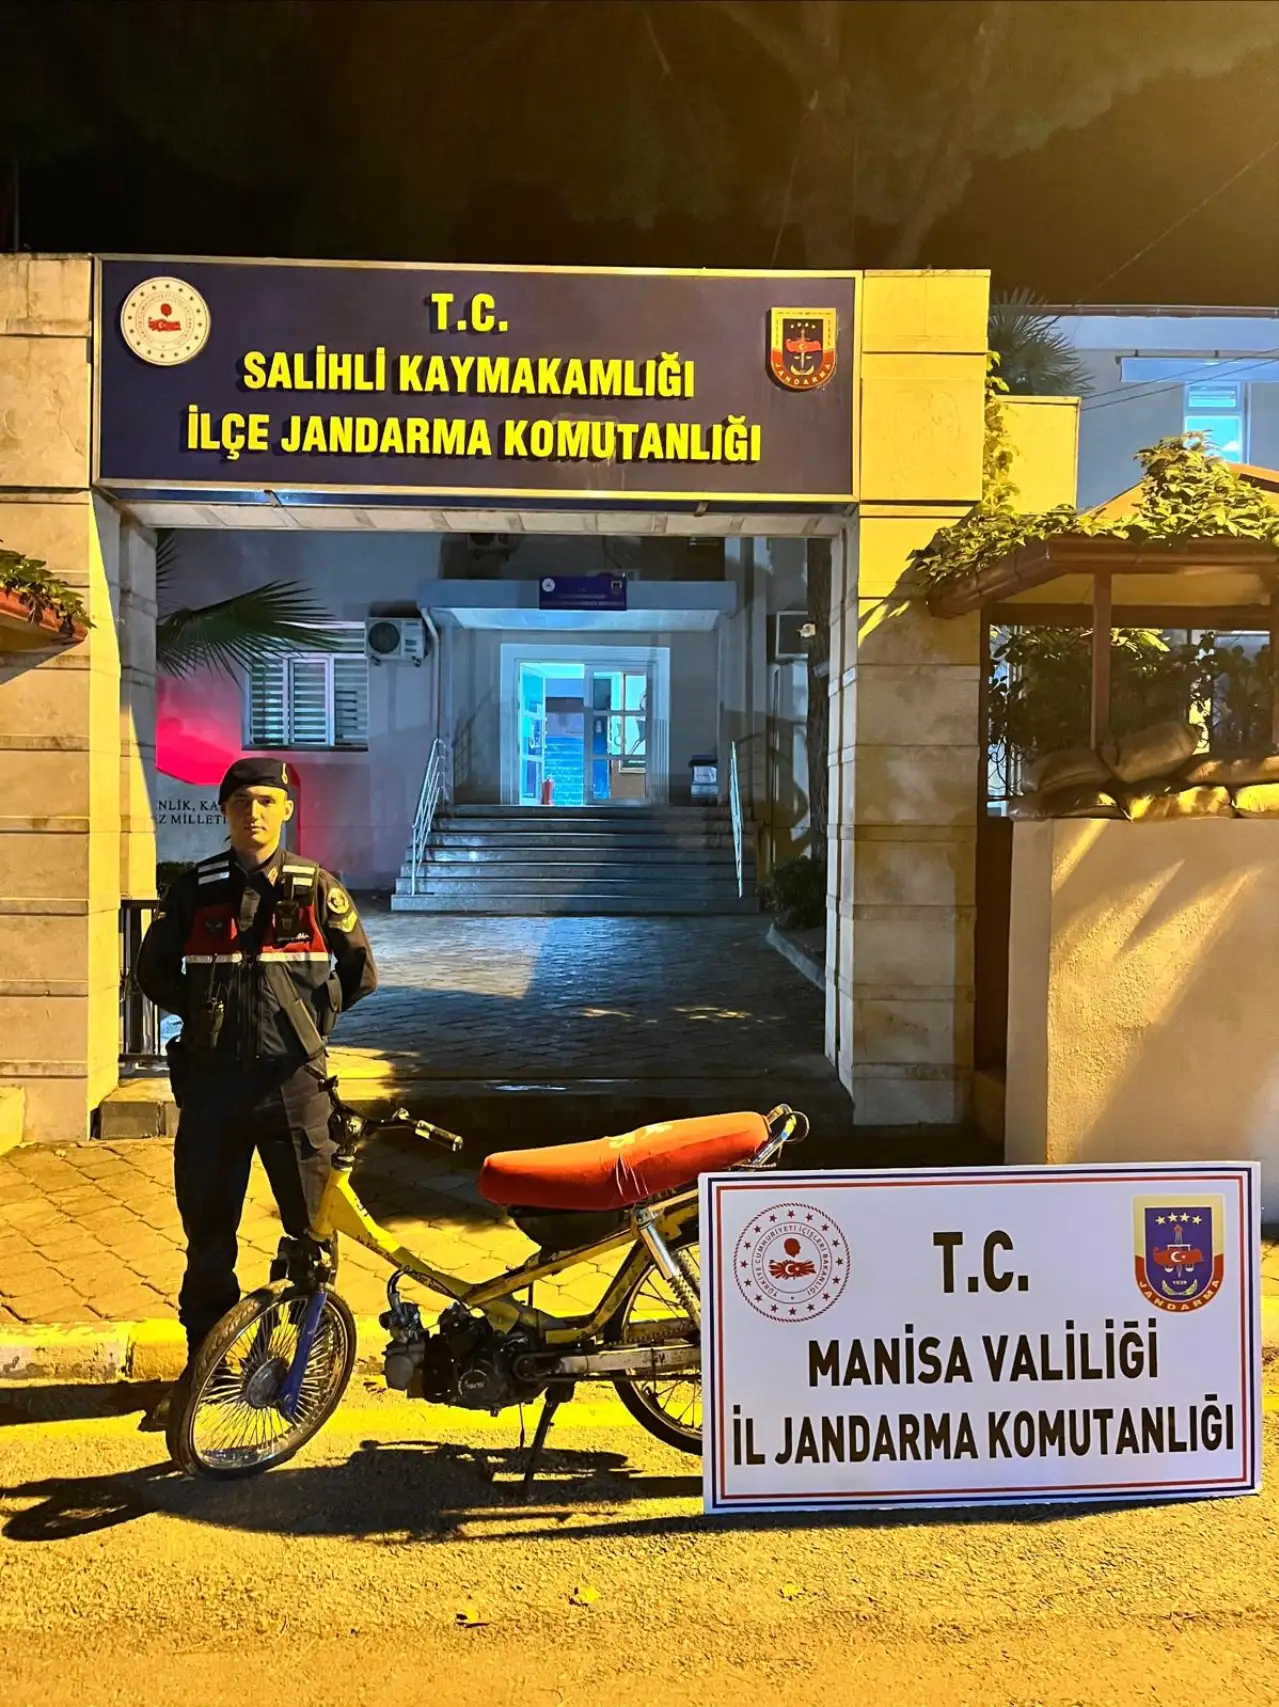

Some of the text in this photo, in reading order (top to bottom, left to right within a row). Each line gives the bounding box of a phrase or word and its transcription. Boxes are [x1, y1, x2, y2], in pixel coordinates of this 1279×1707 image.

[431, 292, 509, 332] T.C.
[243, 345, 695, 398] SALİHLİ KAYMAKAMLIĞI
[188, 404, 761, 463] İLÇE JANDARMA KOMUTANLIĞI
[155, 799, 220, 812] NLİK, KA
[933, 1230, 1029, 1294] T.C.
[1138, 1279, 1220, 1311] JANDARMA
[808, 1317, 1158, 1387] MANİSA VALİLİĞİ
[733, 1394, 1234, 1466] İL JANDARMA KOMUTANLIĞI
